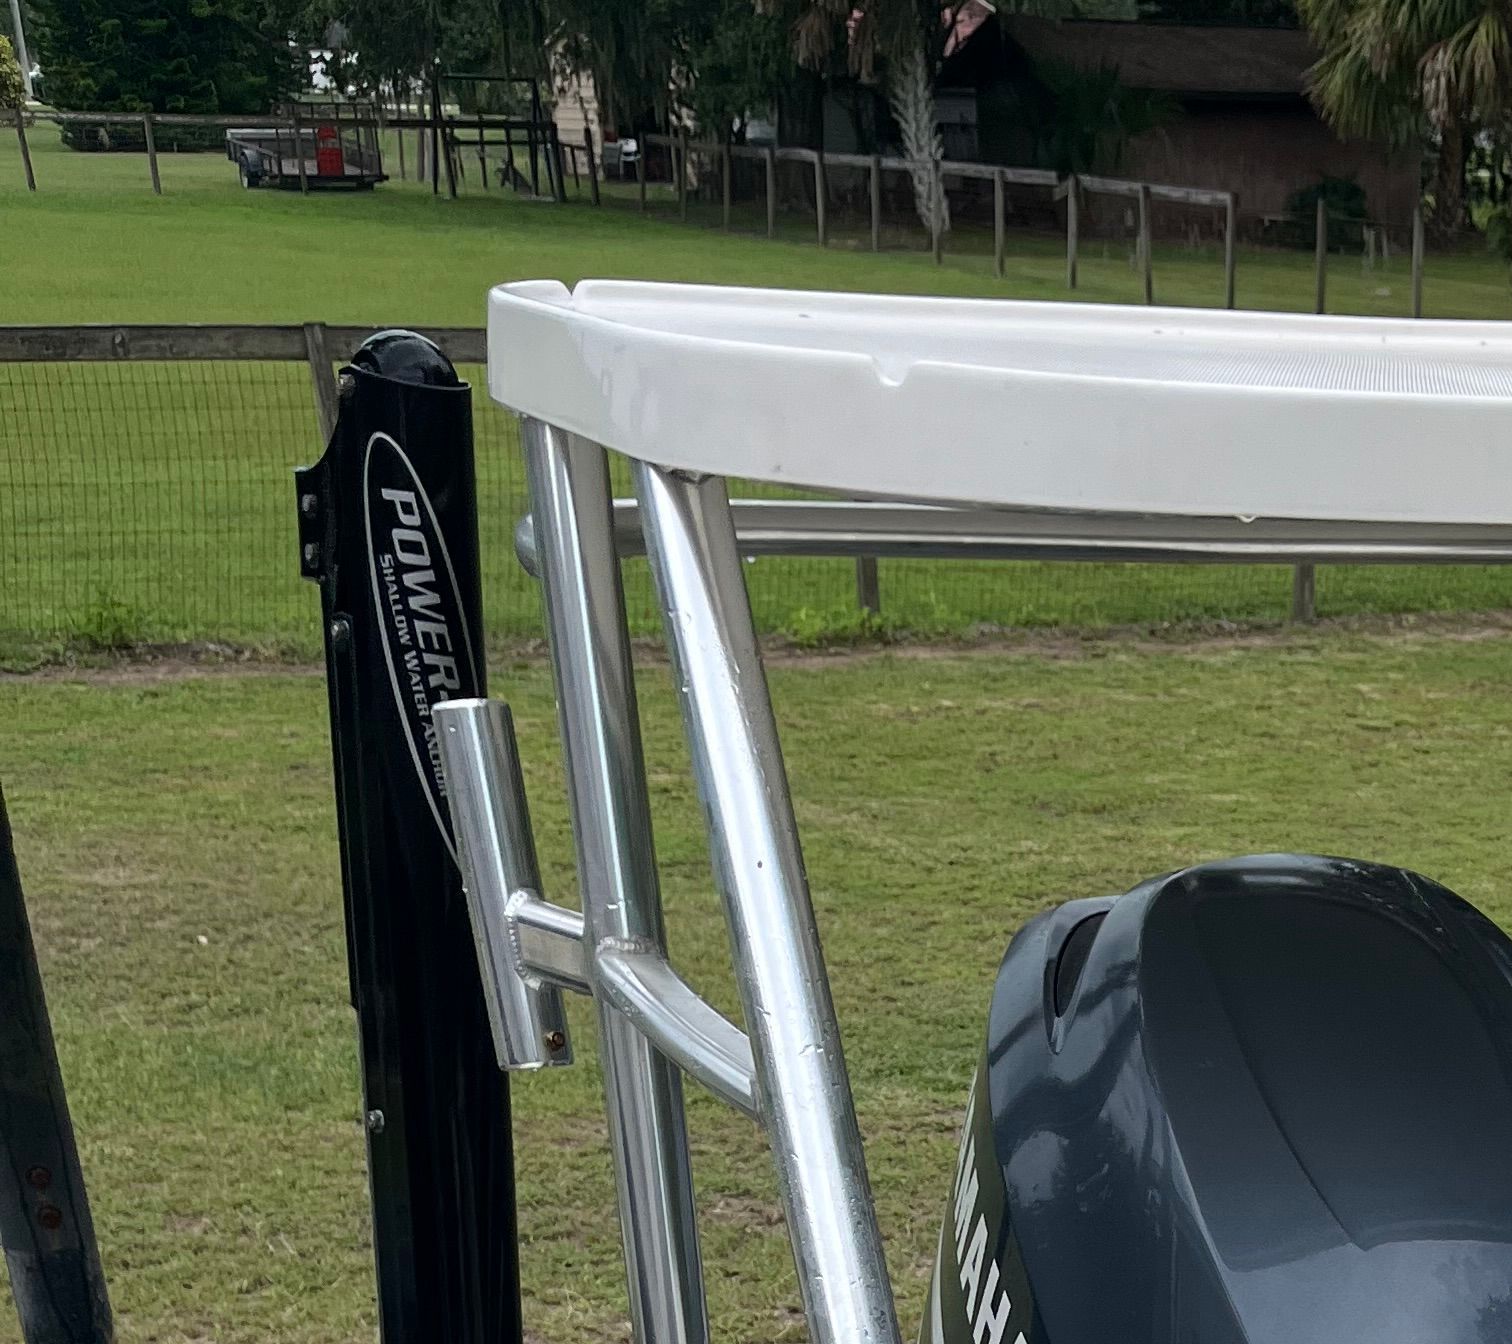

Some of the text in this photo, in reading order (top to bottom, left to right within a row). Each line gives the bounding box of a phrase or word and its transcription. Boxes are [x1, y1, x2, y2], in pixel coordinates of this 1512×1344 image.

[380, 553, 413, 646] SHALLOW
[404, 650, 430, 717] WATER
[381, 487, 461, 702] POWER-
